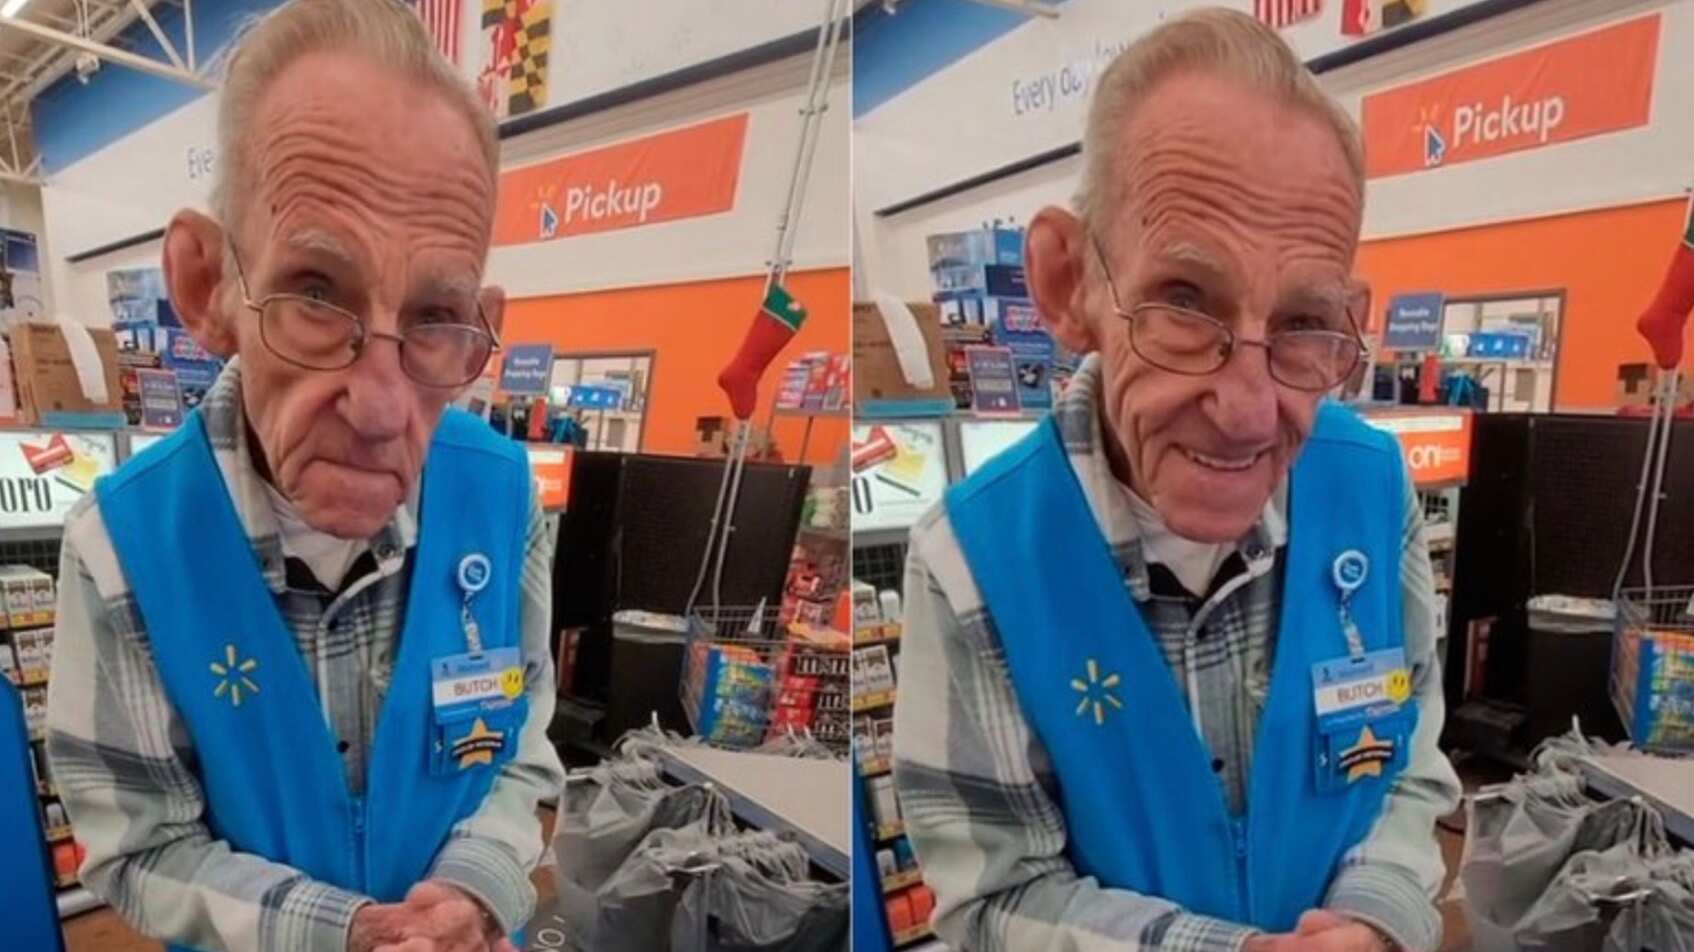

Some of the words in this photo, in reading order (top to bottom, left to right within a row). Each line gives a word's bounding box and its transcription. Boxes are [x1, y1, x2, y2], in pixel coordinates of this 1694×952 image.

[1012, 73, 1056, 116] Every
[1453, 94, 1564, 148] Pickup
[564, 178, 662, 224] Pickup
[454, 676, 500, 697] BUTCH
[1337, 680, 1384, 704] BUTCH
